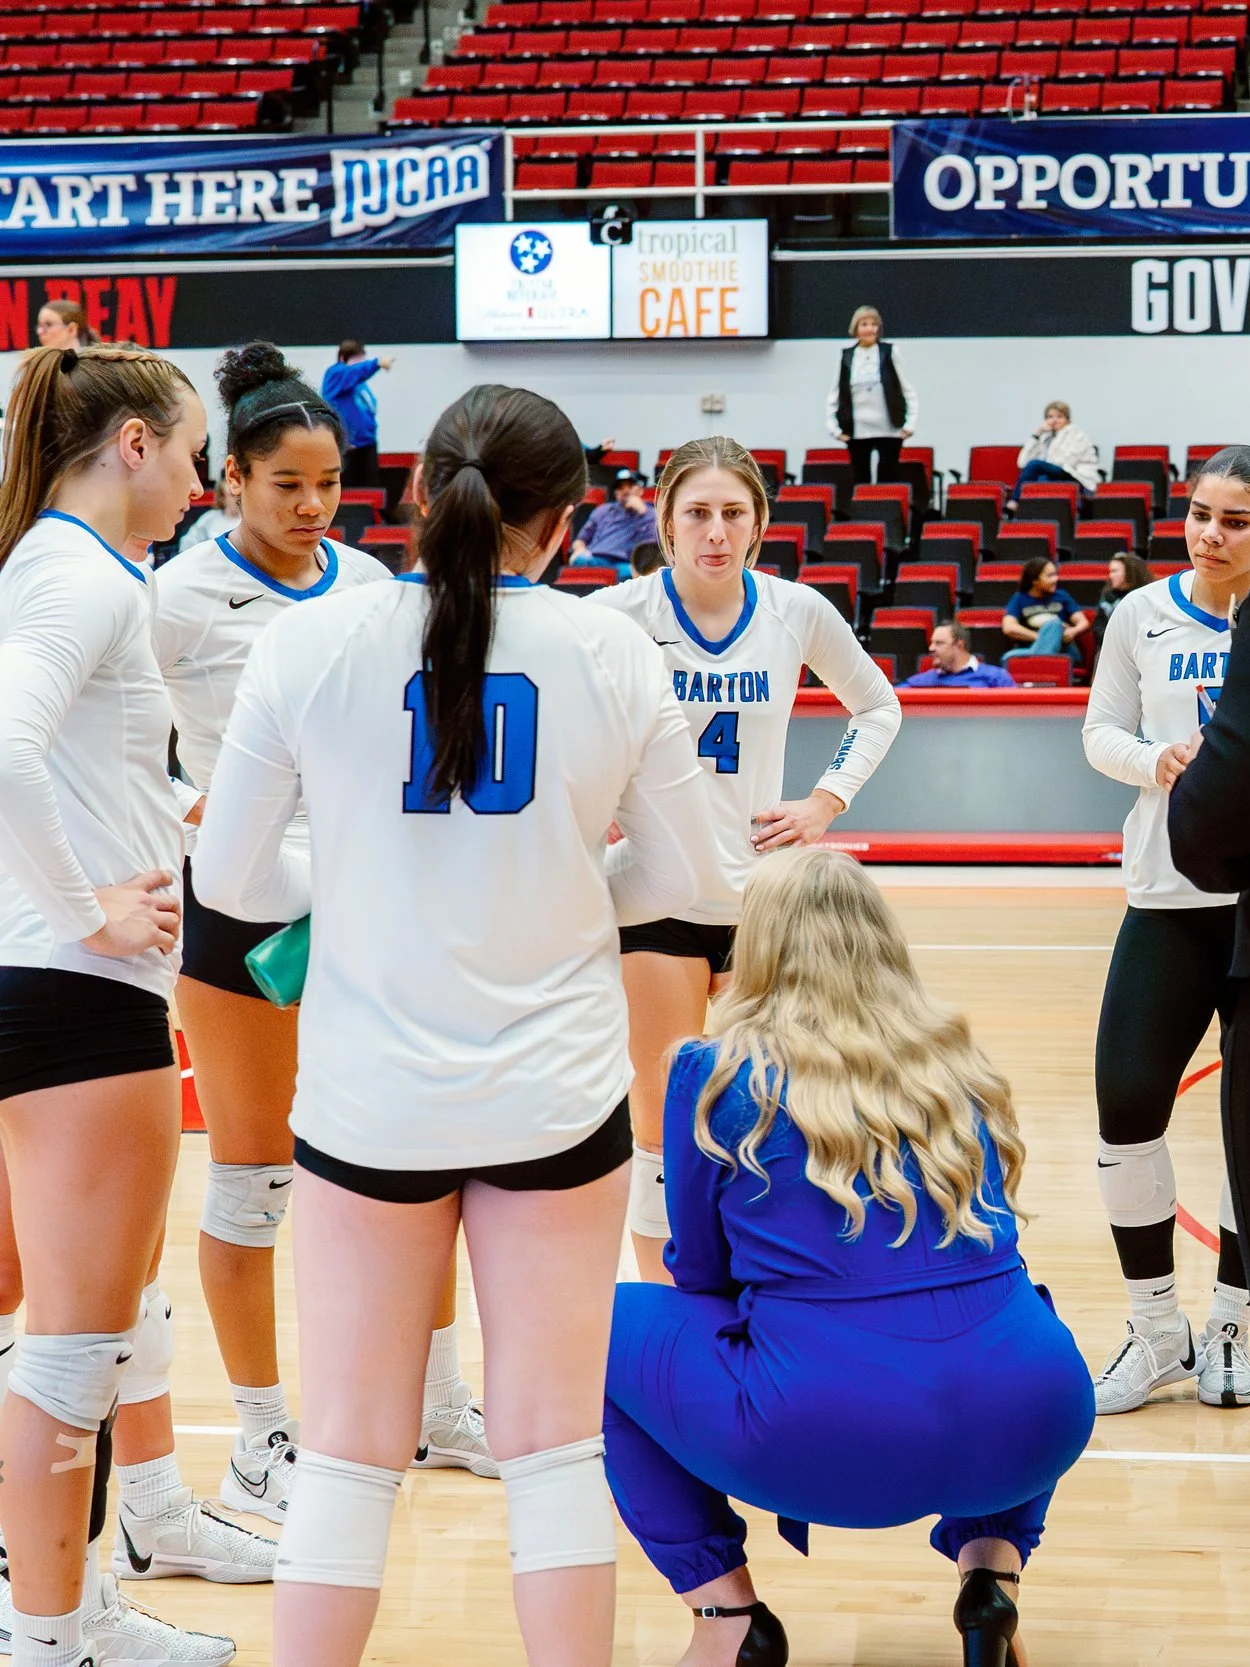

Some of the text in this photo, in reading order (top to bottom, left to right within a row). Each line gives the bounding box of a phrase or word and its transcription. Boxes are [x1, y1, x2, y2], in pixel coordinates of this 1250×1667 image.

[145, 167, 320, 227] HERE
[335, 150, 484, 230] NJCAA
[600, 220, 623, 246] C
[638, 225, 739, 258] tropical
[639, 260, 739, 283] SMOOTHIE
[639, 287, 740, 337] CAFE
[673, 670, 770, 703] BARTON
[403, 670, 538, 815] 10
[698, 711, 740, 774] 4
